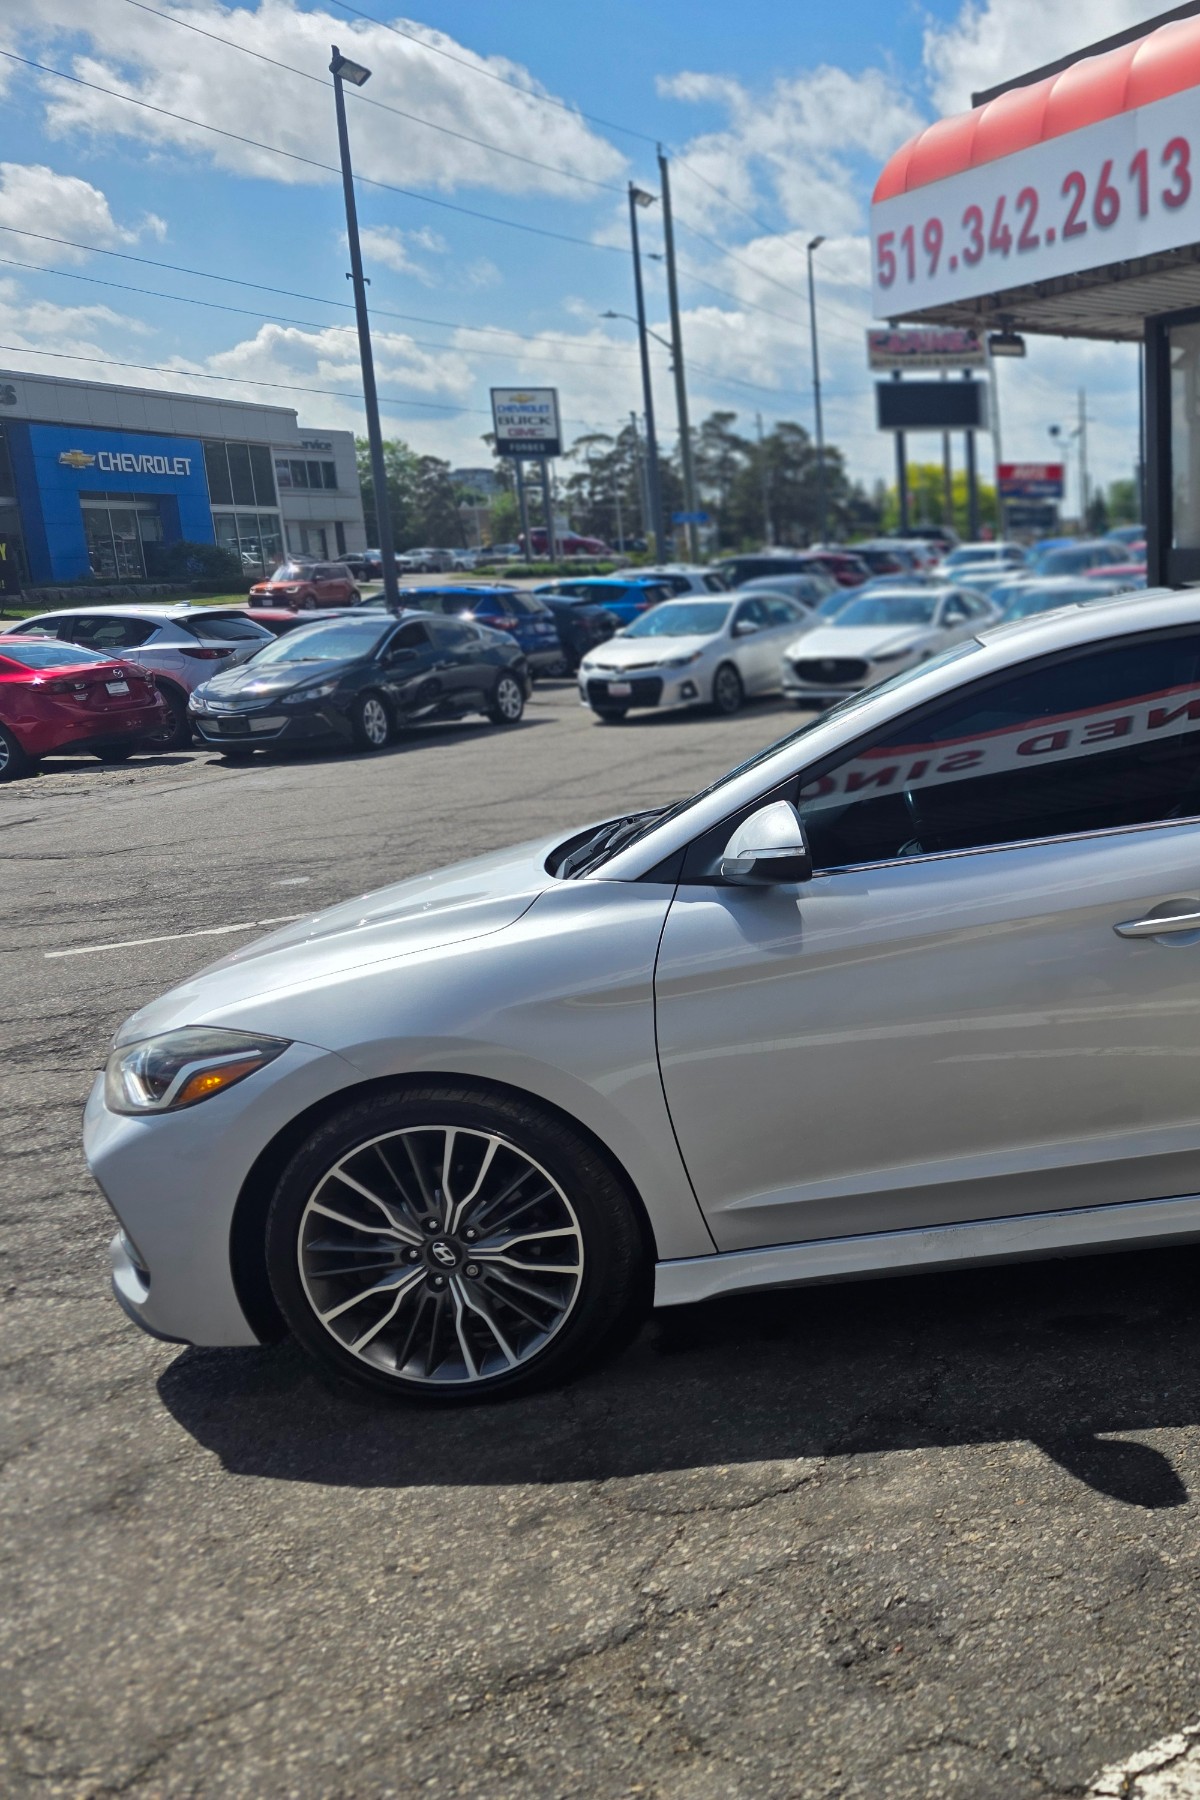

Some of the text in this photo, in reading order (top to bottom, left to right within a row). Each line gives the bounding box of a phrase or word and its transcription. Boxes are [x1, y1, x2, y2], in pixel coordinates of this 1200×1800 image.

[876, 136, 1193, 287] 519.342.2613
[497, 405, 549, 413] CHEVROLET
[498, 416, 552, 425] BUICK
[507, 428, 545, 437] GMC
[98, 451, 192, 476] CHEVROLET
